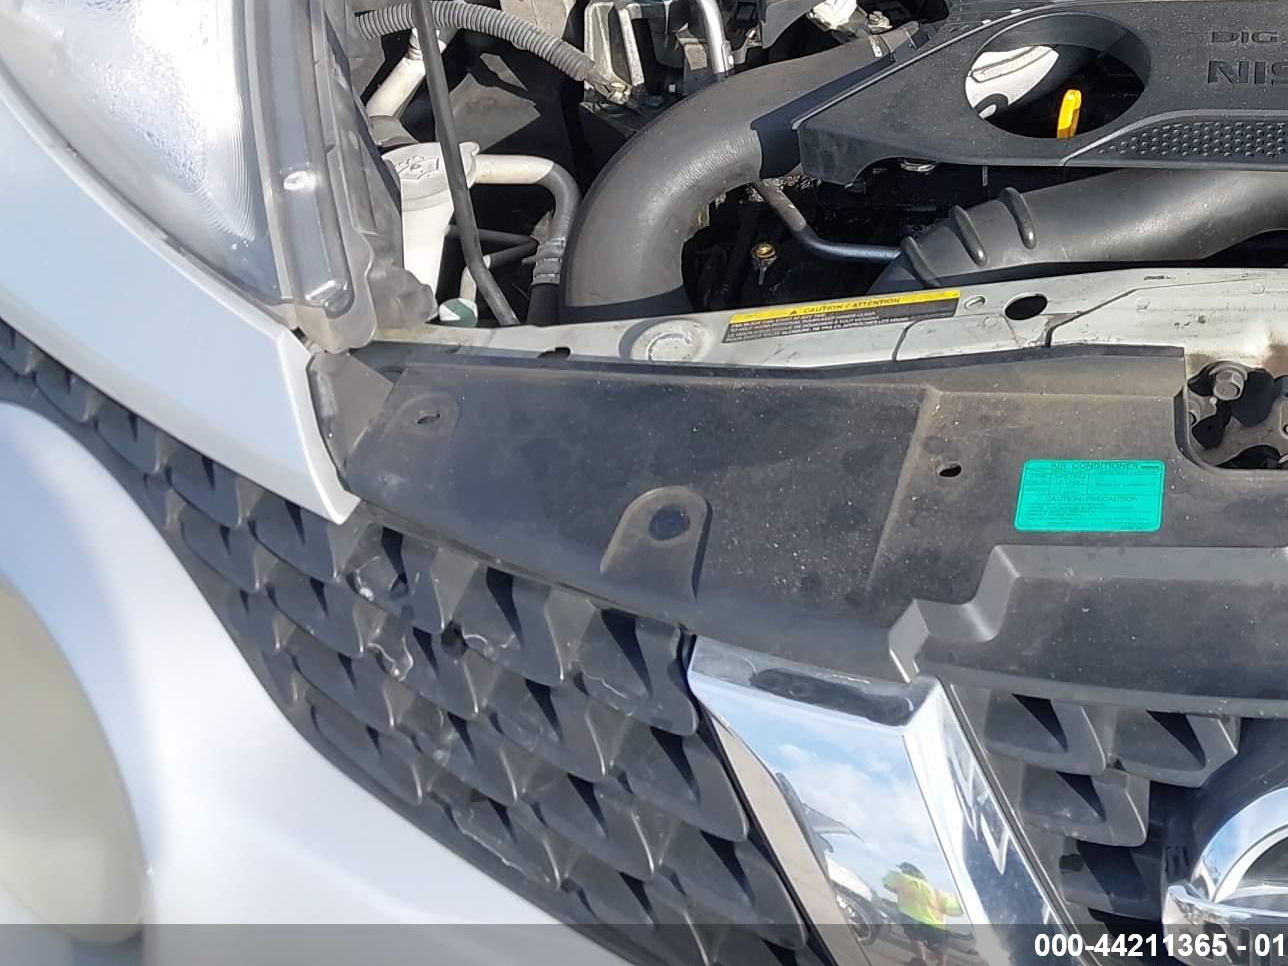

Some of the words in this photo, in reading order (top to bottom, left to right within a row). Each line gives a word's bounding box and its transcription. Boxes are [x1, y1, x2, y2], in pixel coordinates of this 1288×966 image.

[1207, 31, 1279, 44] DIG
[803, 303, 844, 315] CAUTION
[852, 297, 901, 309] ATTENTION
[1051, 462, 1066, 470] AIR
[1071, 462, 1139, 470] CONDITIONER
